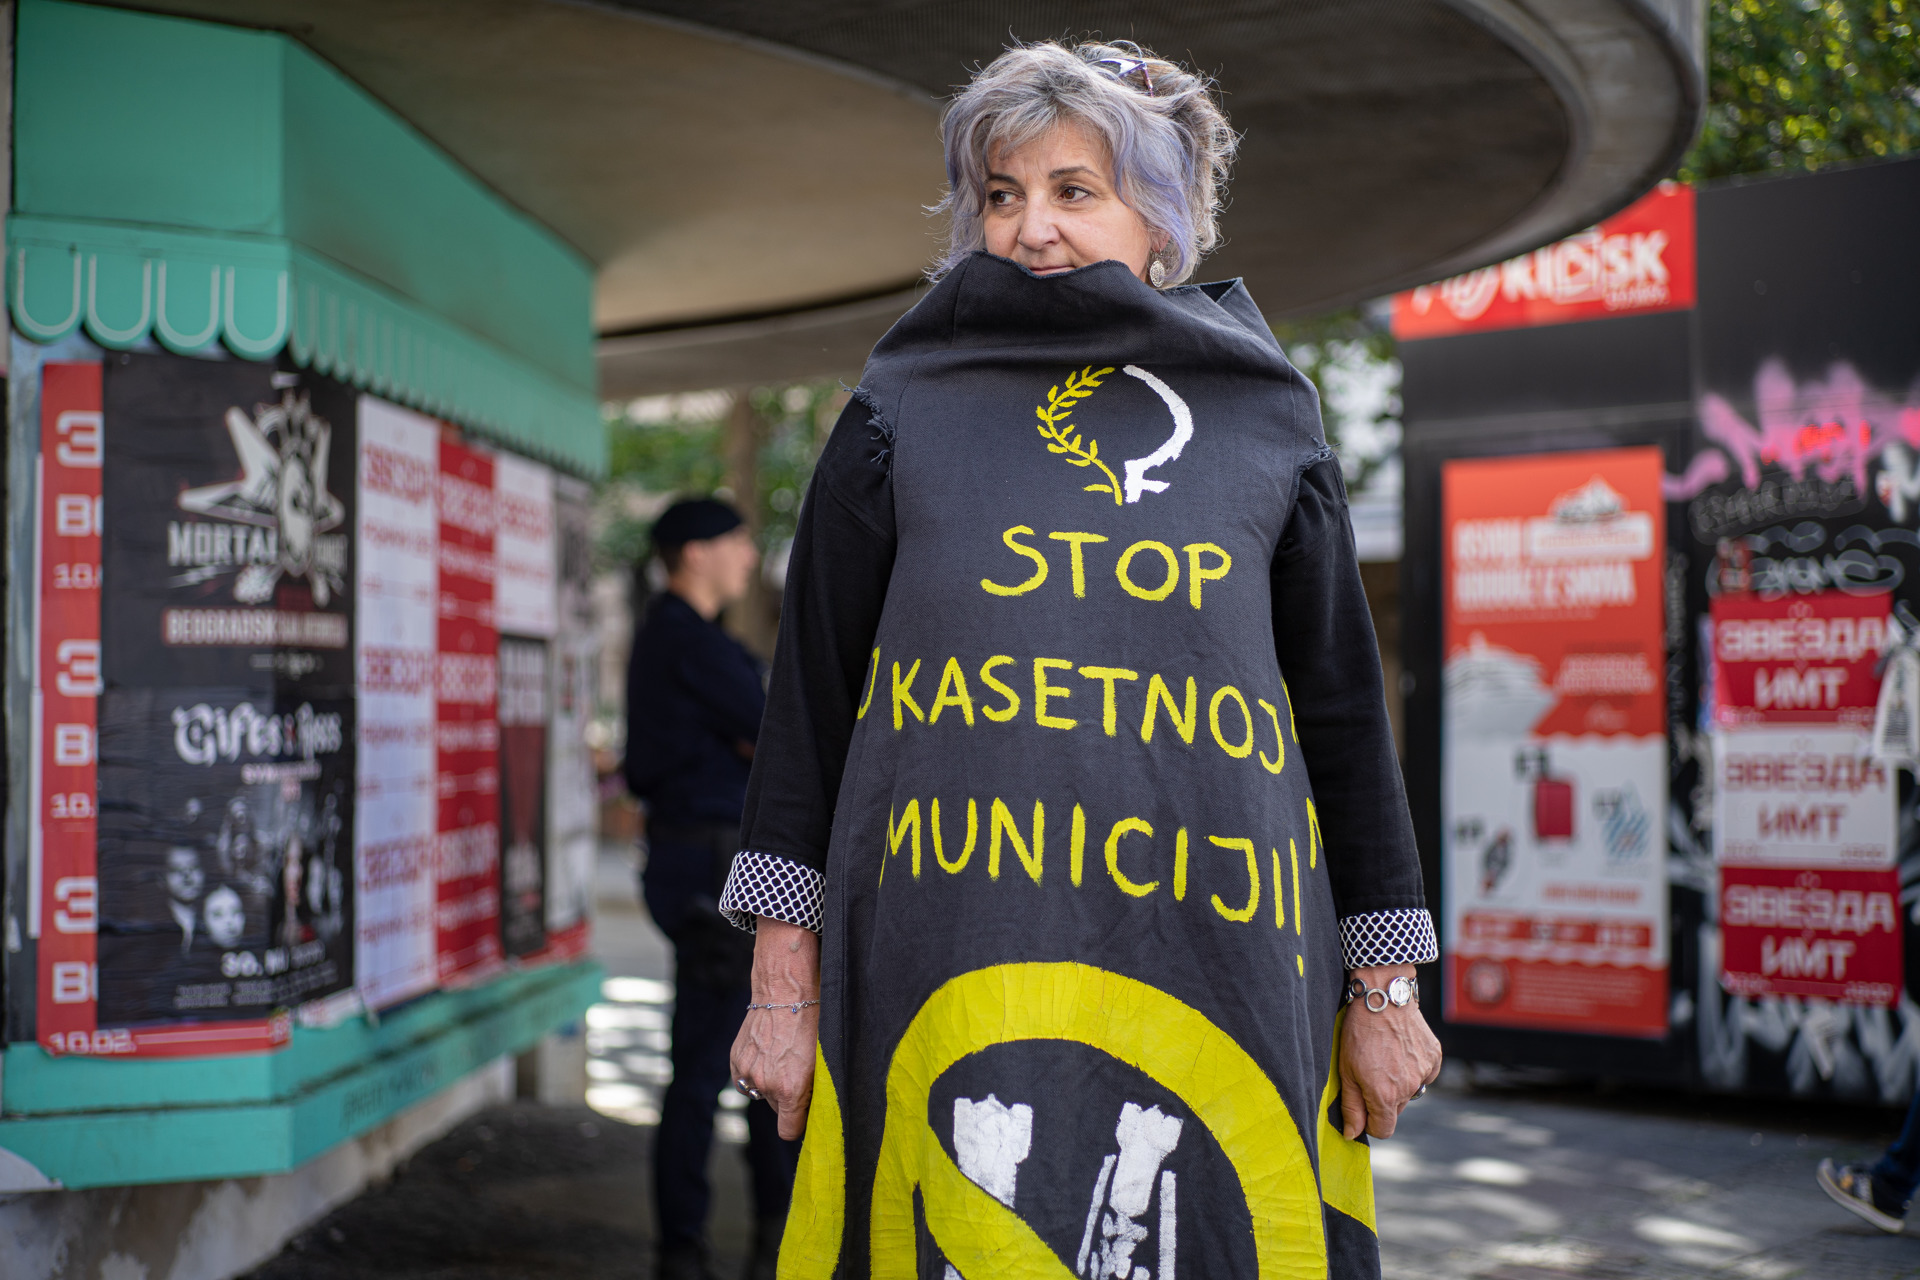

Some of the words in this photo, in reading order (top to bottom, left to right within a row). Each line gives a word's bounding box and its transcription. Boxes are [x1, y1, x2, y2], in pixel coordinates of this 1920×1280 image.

[981, 525, 1231, 609] STOP
[1719, 617, 1885, 663] ЗВЕЗДА
[1754, 667, 1848, 710] ИМТ
[892, 655, 1284, 774] KASETNOJ
[1722, 754, 1886, 795] ЗВЕЗДА
[1758, 802, 1847, 842] ИМТ
[880, 798, 1303, 976] MUNICIJI!
[1724, 884, 1896, 937] ЗВЕЗДА
[1761, 934, 1856, 981] ИМТ
